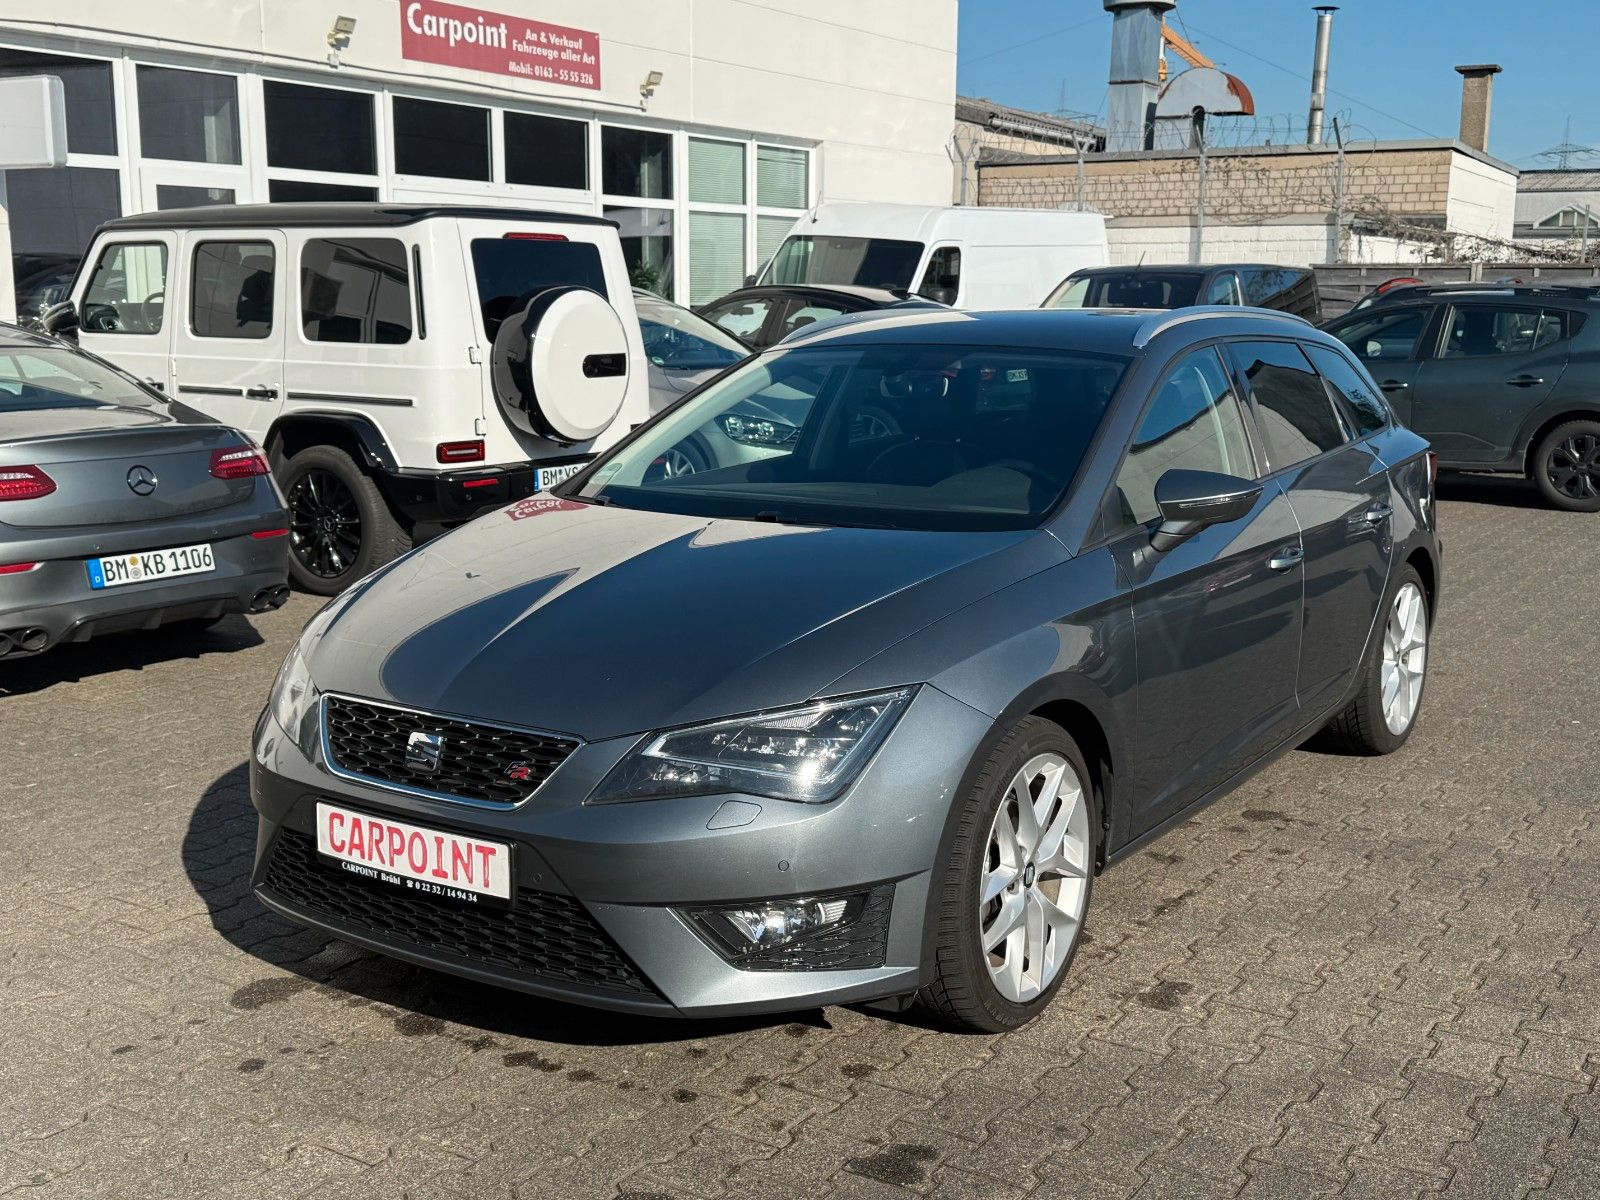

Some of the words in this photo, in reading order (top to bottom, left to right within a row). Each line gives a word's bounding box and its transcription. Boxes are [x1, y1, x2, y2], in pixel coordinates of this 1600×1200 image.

[407, 2, 507, 48] Carpoint
[526, 28, 537, 41] An
[540, 31, 547, 44] &
[549, 33, 582, 50] Verkauf
[512, 40, 559, 60] Fahrzeuge
[561, 49, 581, 62] aller
[583, 53, 595, 65] Art
[509, 61, 533, 75] Mobil:
[535, 65, 552, 79] 0163
[560, 69, 569, 81] 55
[570, 71, 579, 83] 55
[542, 469, 558, 486] BM
[102, 558, 130, 582] BM
[143, 553, 166, 575] KB
[169, 547, 212, 571] 1106
[328, 812, 497, 888] CARPOINT
[341, 861, 378, 879] CARPOINT
[381, 872, 401, 885] Brühl
[421, 882, 431, 892] 22
[432, 885, 441, 895] 32
[447, 888, 456, 898] 14
